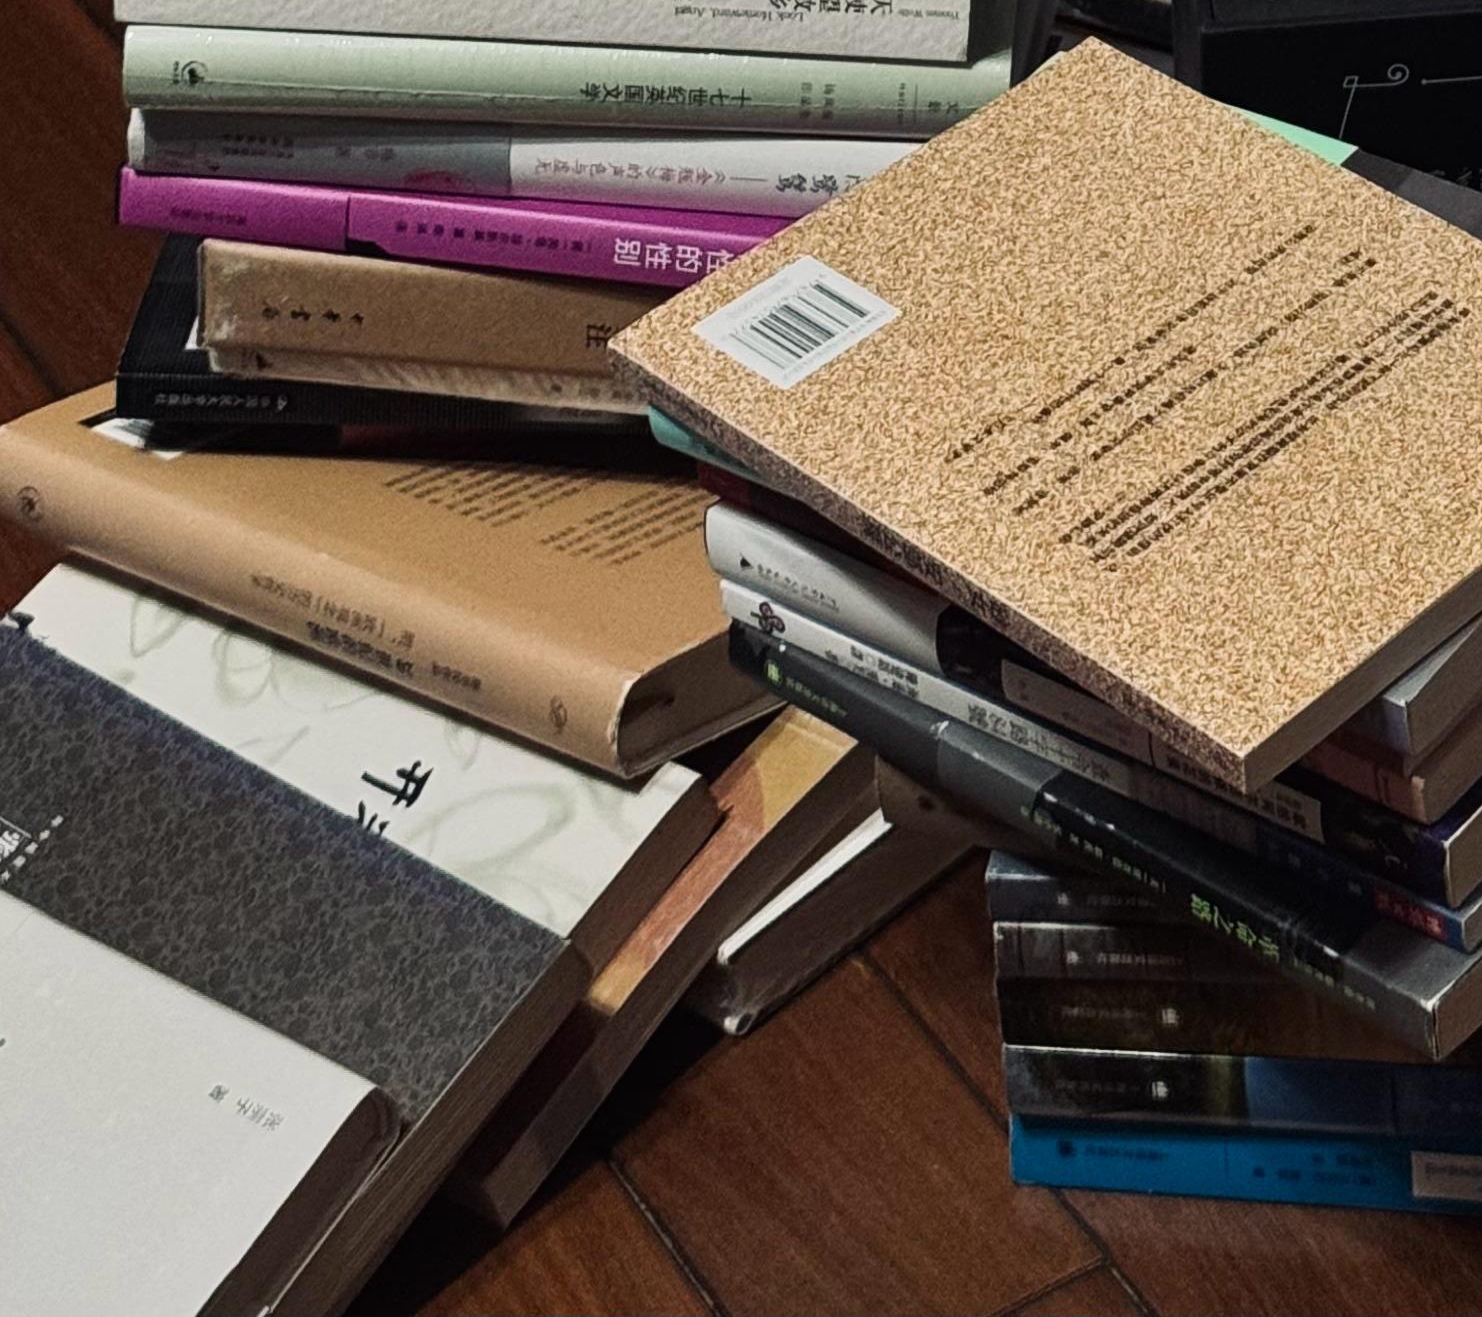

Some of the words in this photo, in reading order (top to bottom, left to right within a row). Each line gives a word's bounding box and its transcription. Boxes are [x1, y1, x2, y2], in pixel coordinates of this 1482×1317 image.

[578, 80, 752, 108] 十七世纪英国文学
